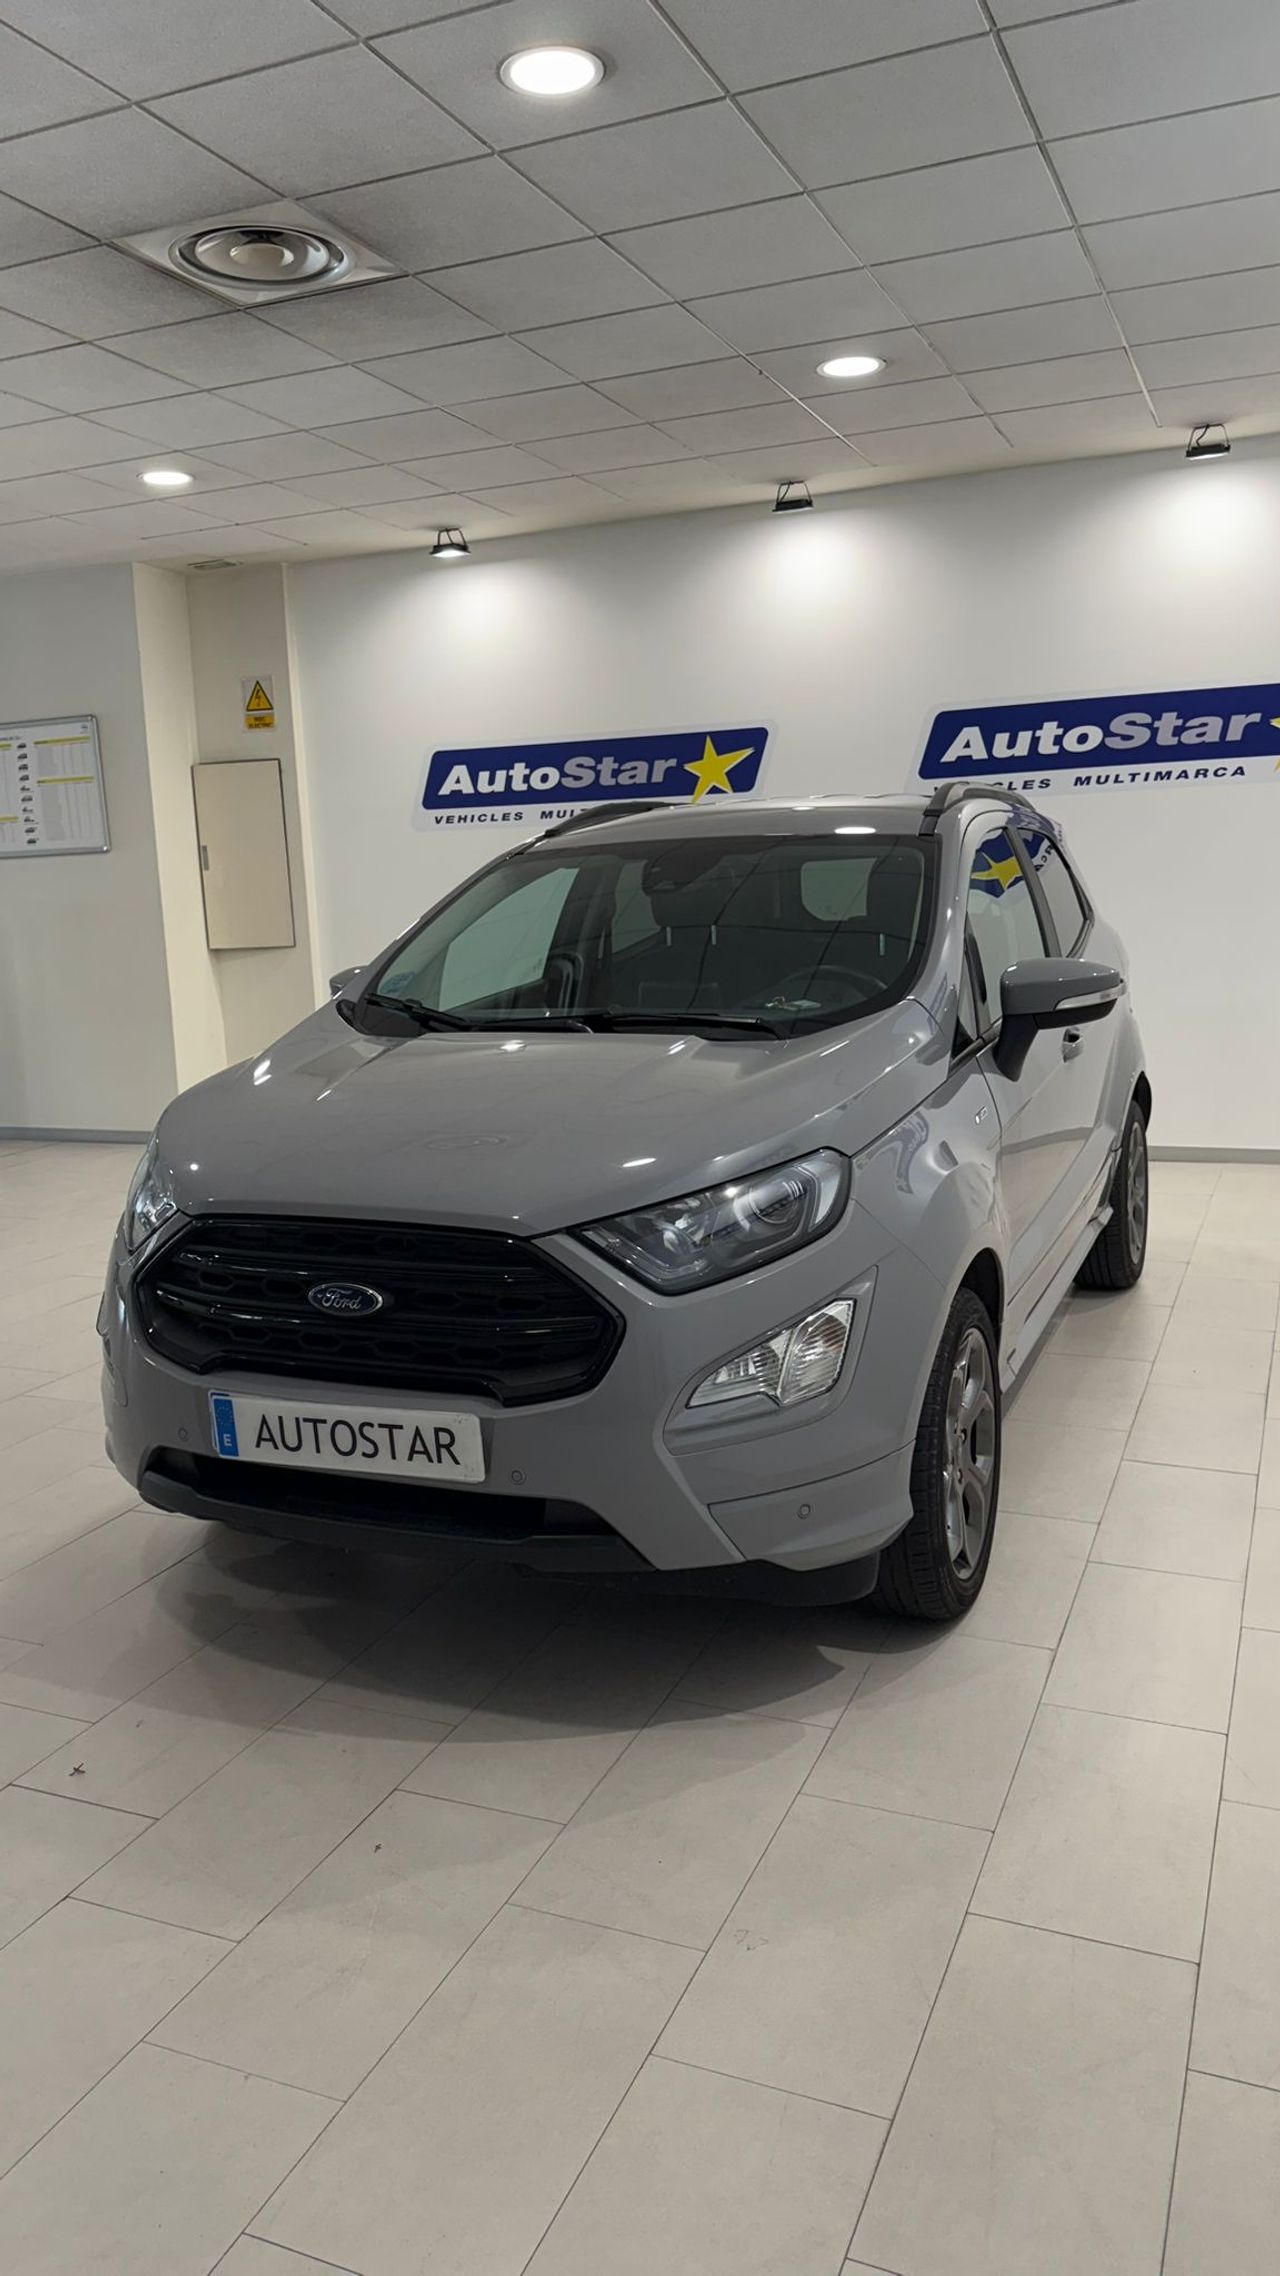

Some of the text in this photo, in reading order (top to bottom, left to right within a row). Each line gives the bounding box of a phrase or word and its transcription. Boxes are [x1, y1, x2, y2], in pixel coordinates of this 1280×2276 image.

[940, 712, 1262, 763] AutoStar
[438, 756, 677, 796] AutoStar
[1073, 766, 1246, 787] MULTIMARCA
[434, 811, 524, 824] VEHICLES
[322, 1288, 361, 1309] Ford
[223, 1414, 461, 1466] E AUTOSTAR
